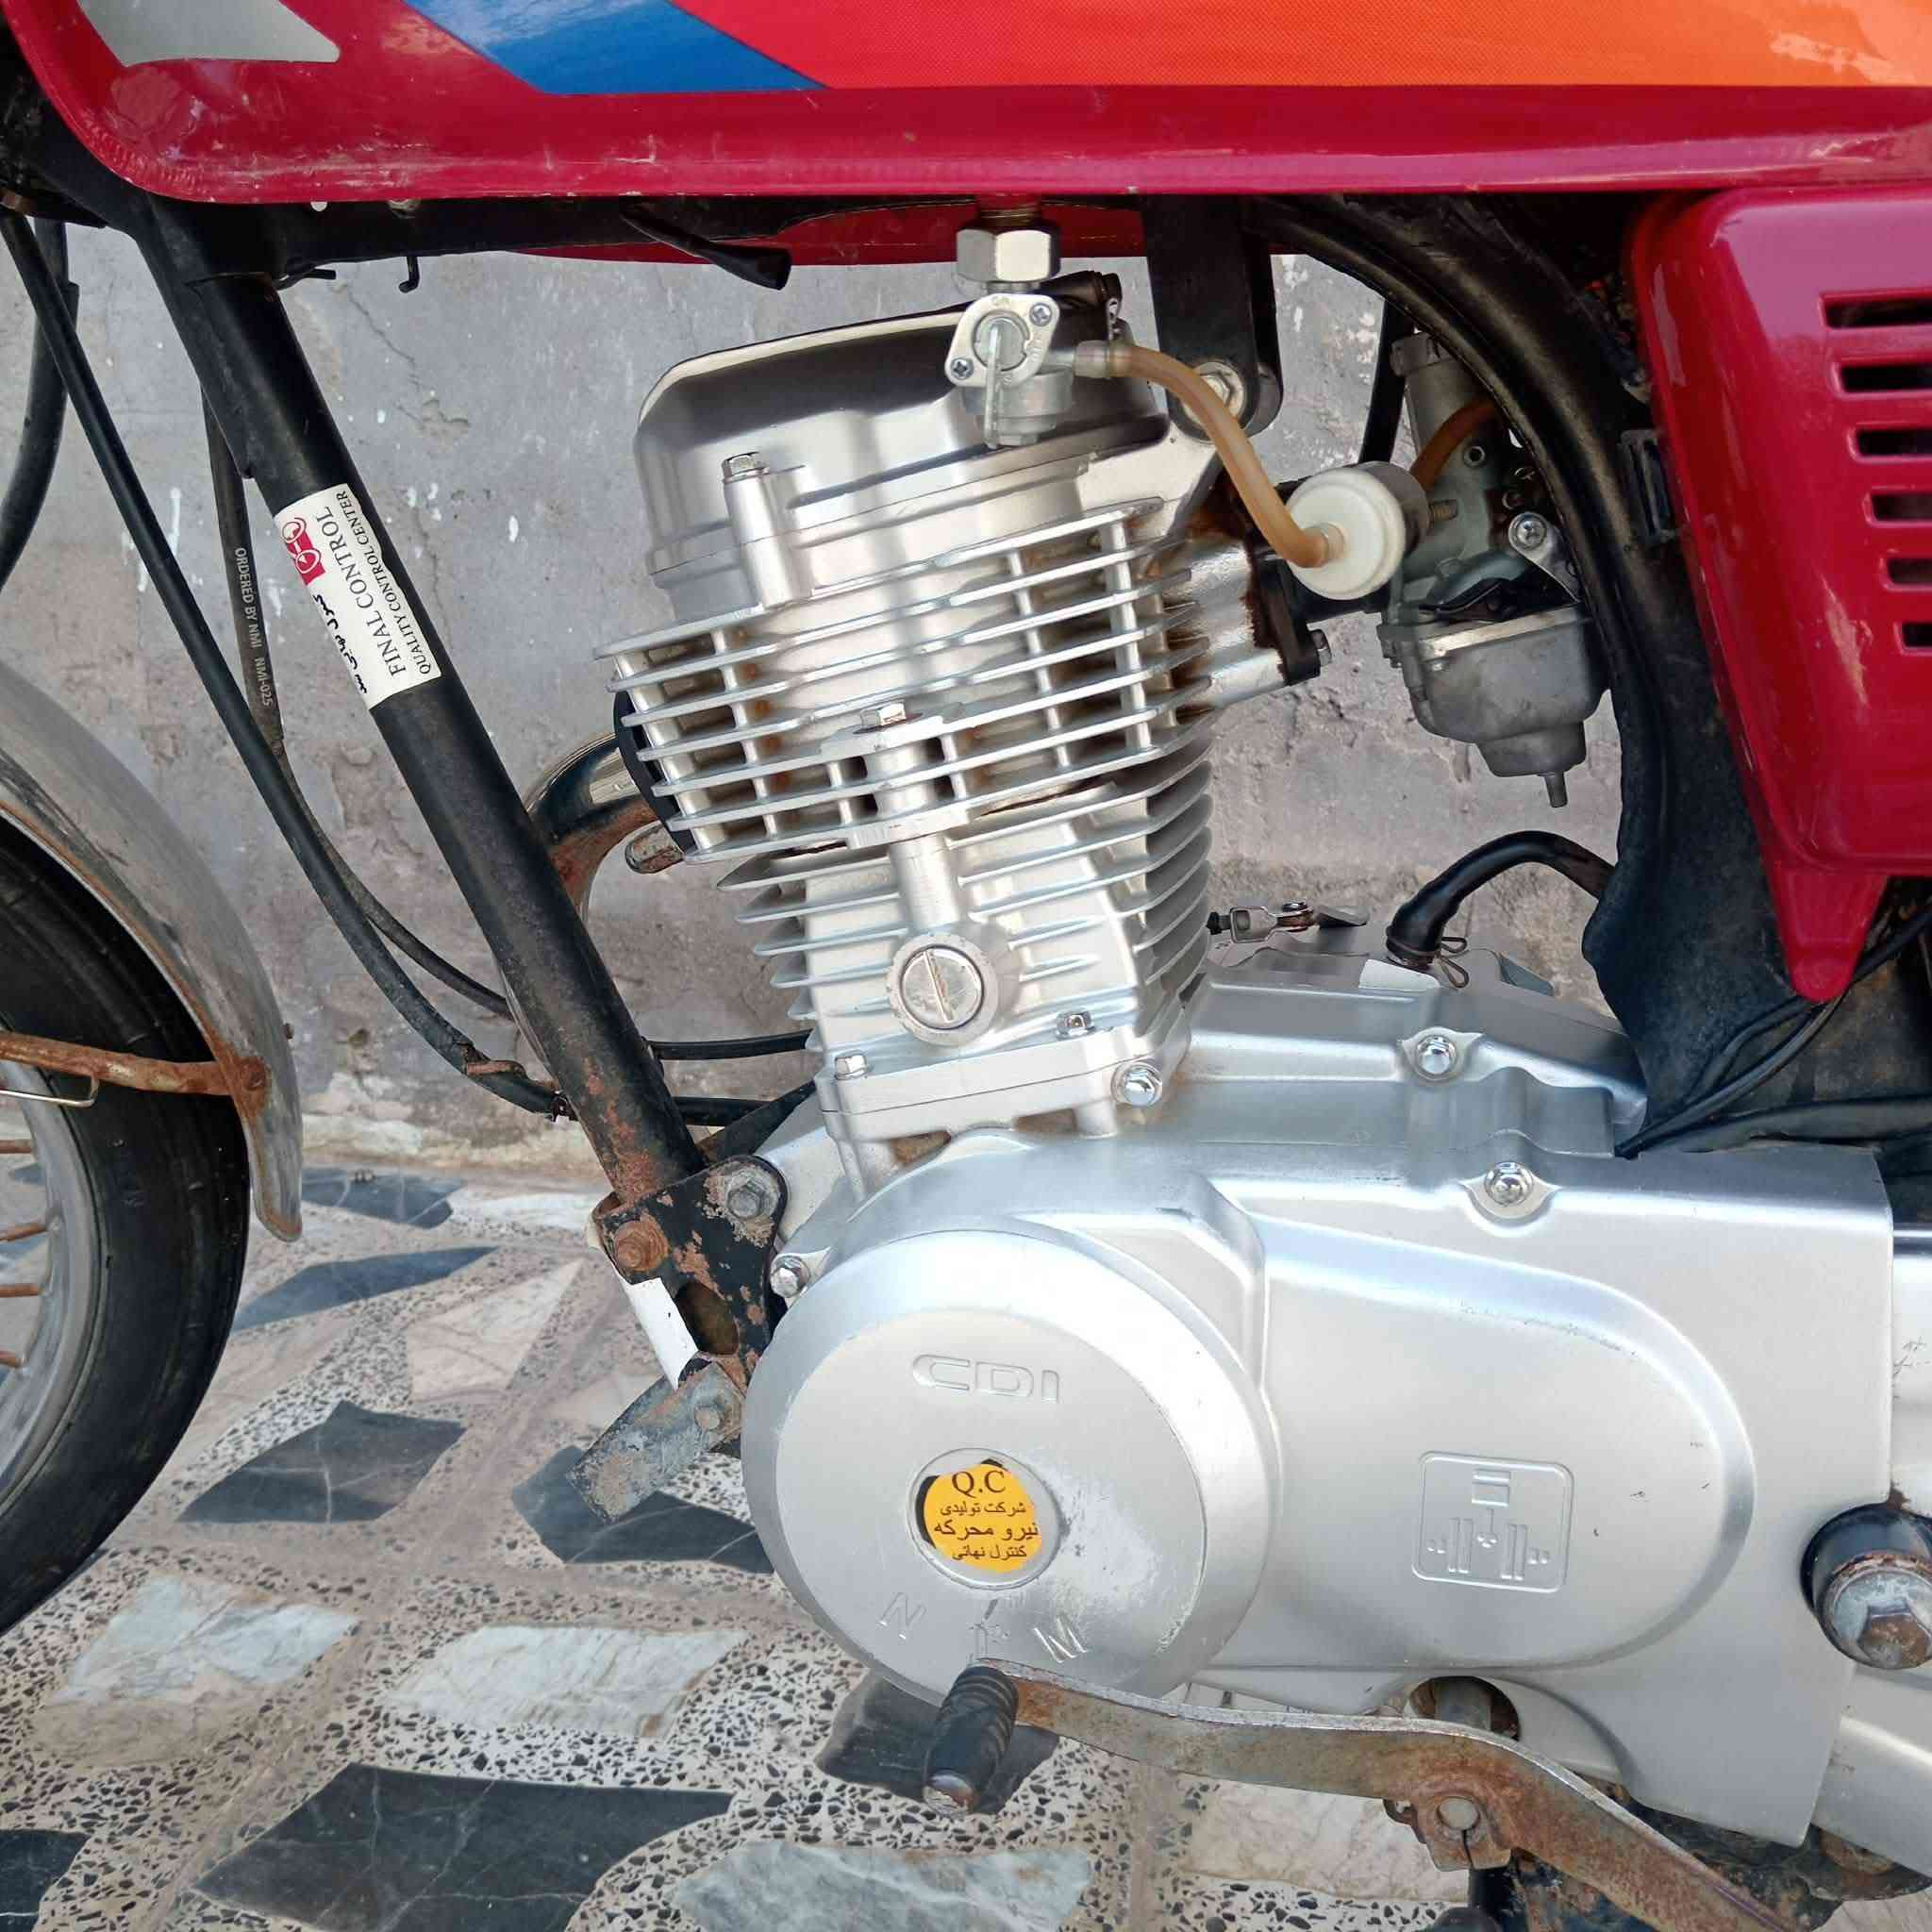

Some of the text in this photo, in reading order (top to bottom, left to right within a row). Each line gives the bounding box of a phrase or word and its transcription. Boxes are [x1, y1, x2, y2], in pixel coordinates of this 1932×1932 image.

[316, 506, 407, 677] FINAL CONTROL
[335, 489, 431, 675] QUALITY CONTROL CENTER
[235, 547, 274, 707] ORDERED BY NMI NMI-025
[912, 1354, 1060, 1404] CDI
[951, 1470, 1007, 1498] Q.C
[940, 1501, 1027, 1517] شرکت تولیدی
[934, 1519, 1039, 1541] نیرو محرکه
[991, 1545, 1027, 1560] کنترل
